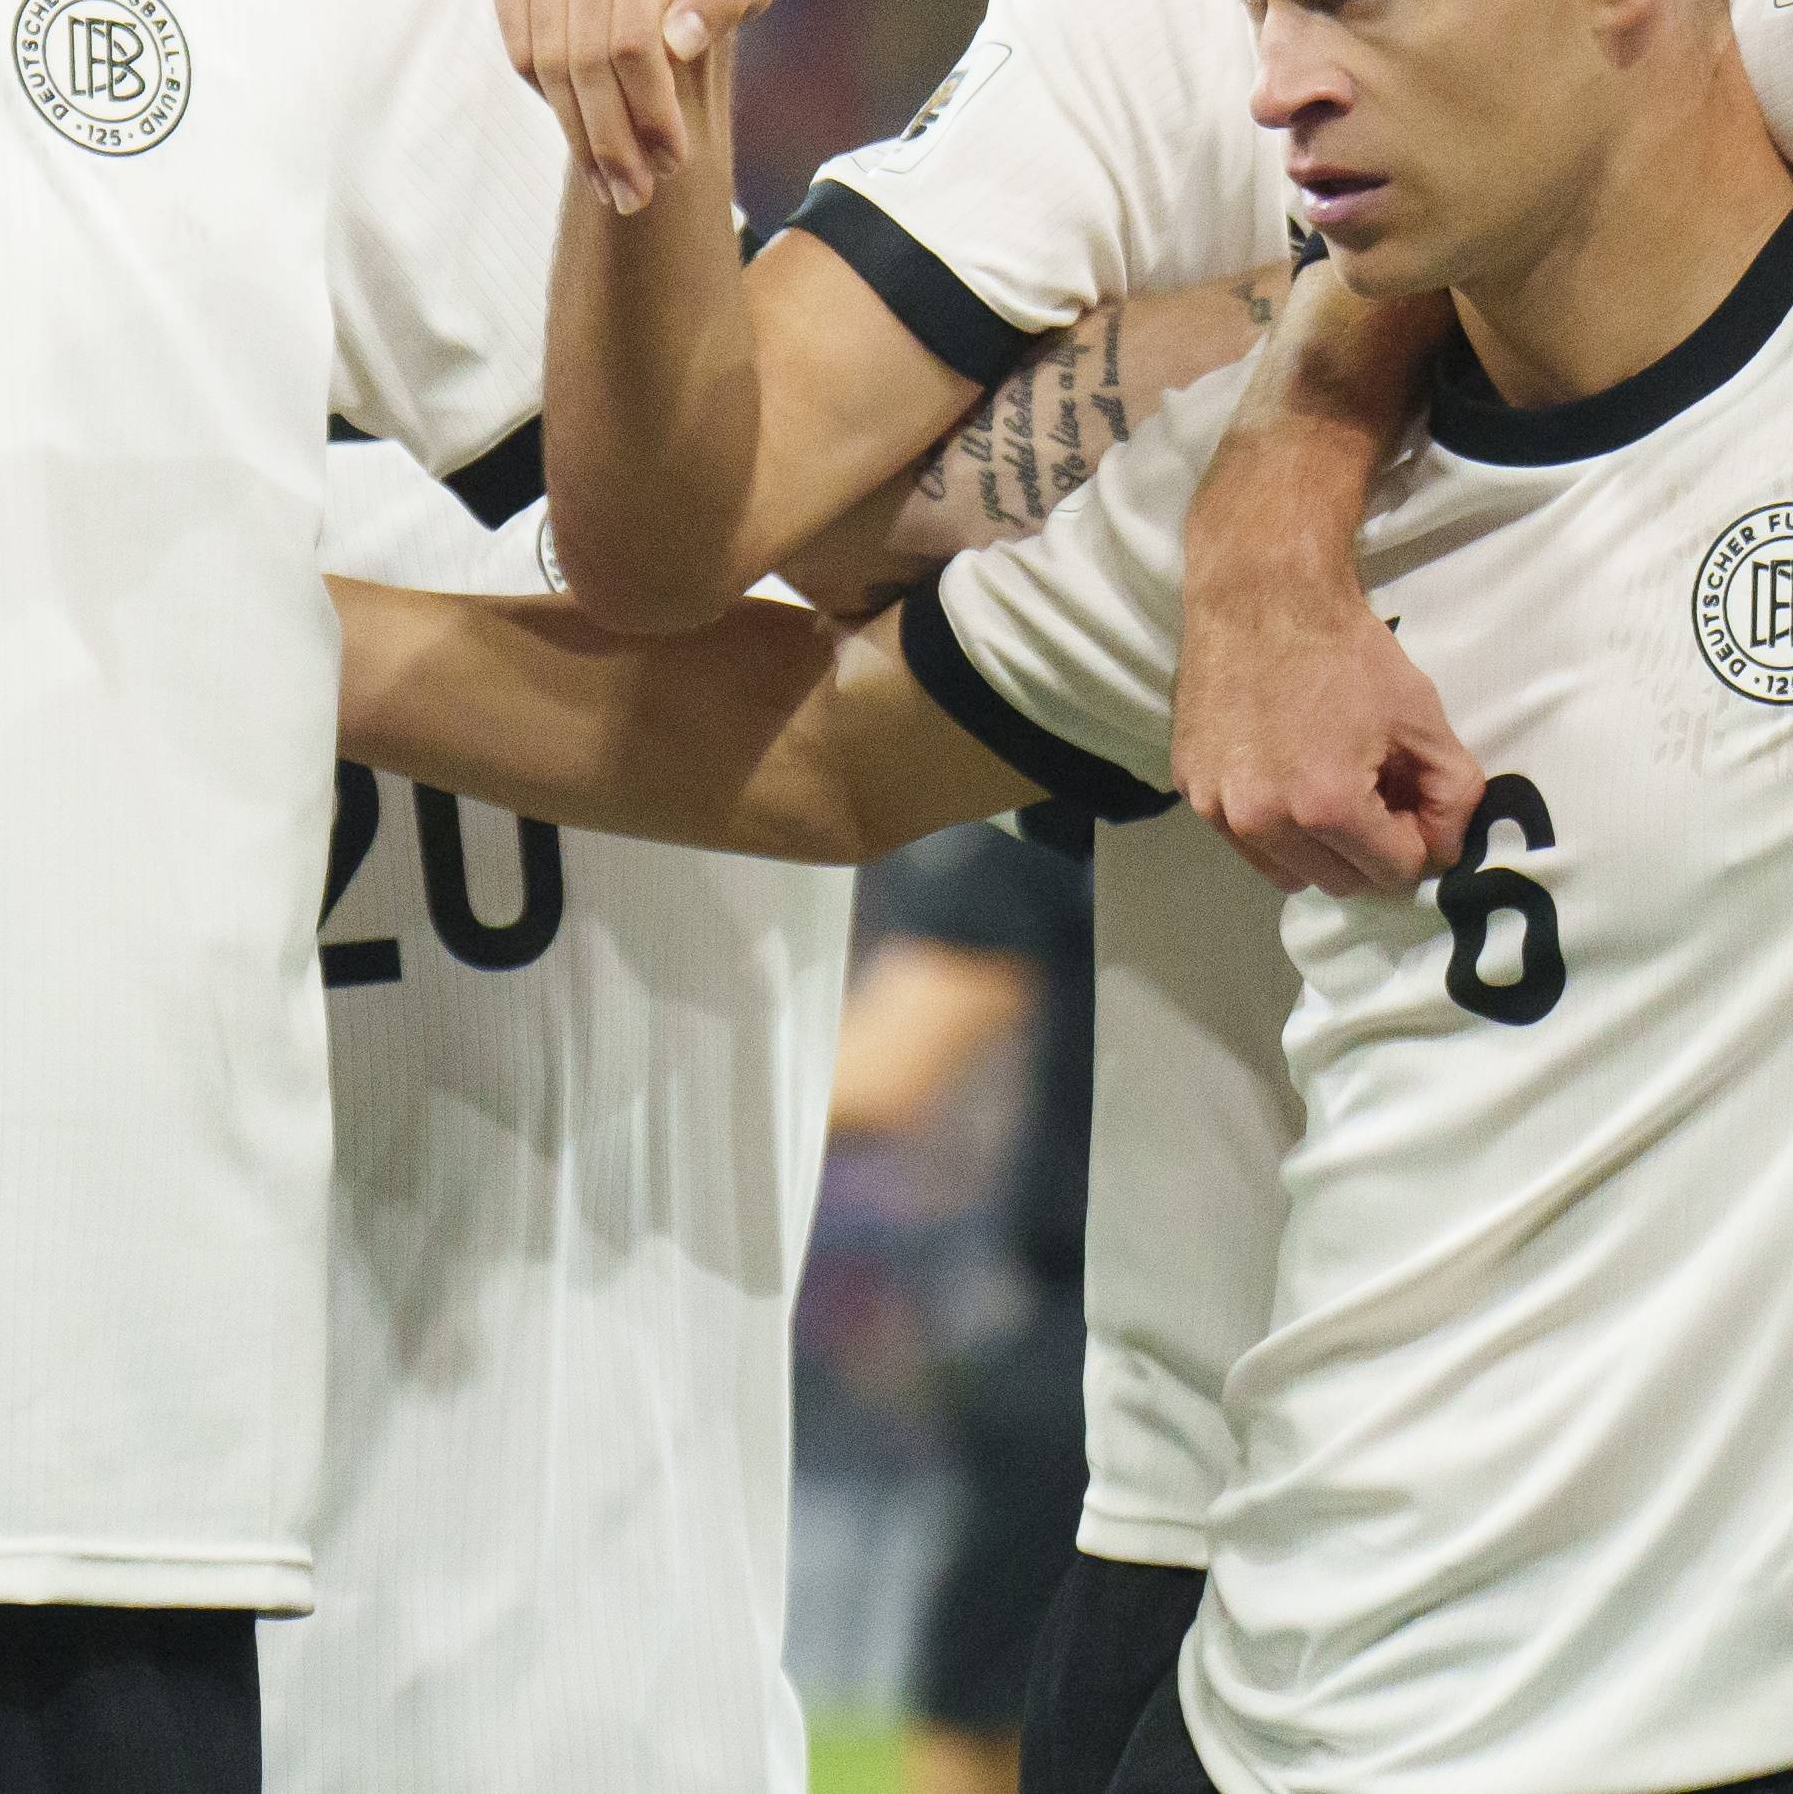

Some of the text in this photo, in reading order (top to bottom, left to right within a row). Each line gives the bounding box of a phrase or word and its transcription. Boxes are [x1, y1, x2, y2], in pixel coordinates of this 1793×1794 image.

[87, 123, 122, 147] 125
[1702, 525, 1757, 678] DEUTSCHER
[1436, 771, 1567, 1027] 6
